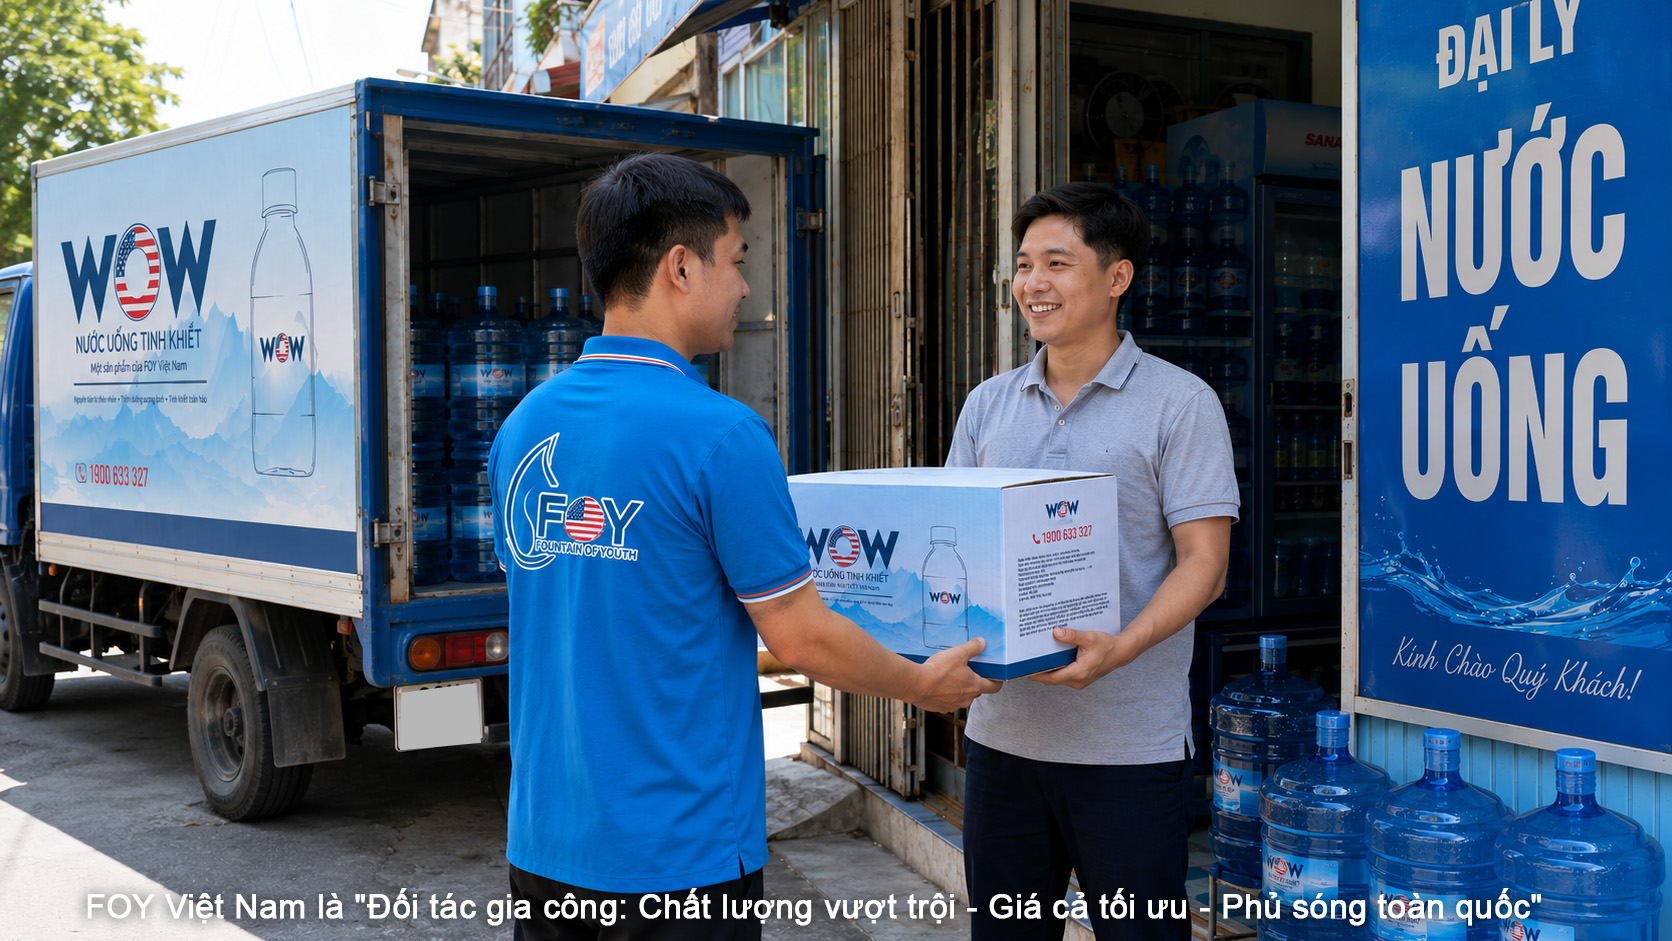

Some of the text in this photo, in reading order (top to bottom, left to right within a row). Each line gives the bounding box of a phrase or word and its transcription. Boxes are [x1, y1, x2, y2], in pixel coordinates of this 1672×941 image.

[1436, 7, 1512, 93] ĐẠI
[1401, 102, 1626, 302] NƯỚC
[61, 219, 217, 325] WOW
[76, 321, 202, 354] NƯỚC UỐNG TINH KHIẾT
[259, 332, 305, 363] WOW
[171, 361, 188, 372] Nam
[1401, 305, 1629, 507] UỐNG
[90, 464, 148, 487] 1900 633 327
[536, 492, 645, 547] FOY
[1045, 500, 1079, 519] WOW
[1041, 525, 1093, 544] 1900 633 327
[535, 539, 638, 561] FOUNTAIN OF YOUTH
[929, 591, 961, 604] WOW
[1392, 636, 1642, 701] Kính Chào Quý Khách!
[1267, 855, 1304, 879] WOW
[1503, 918, 1541, 941] WOW
